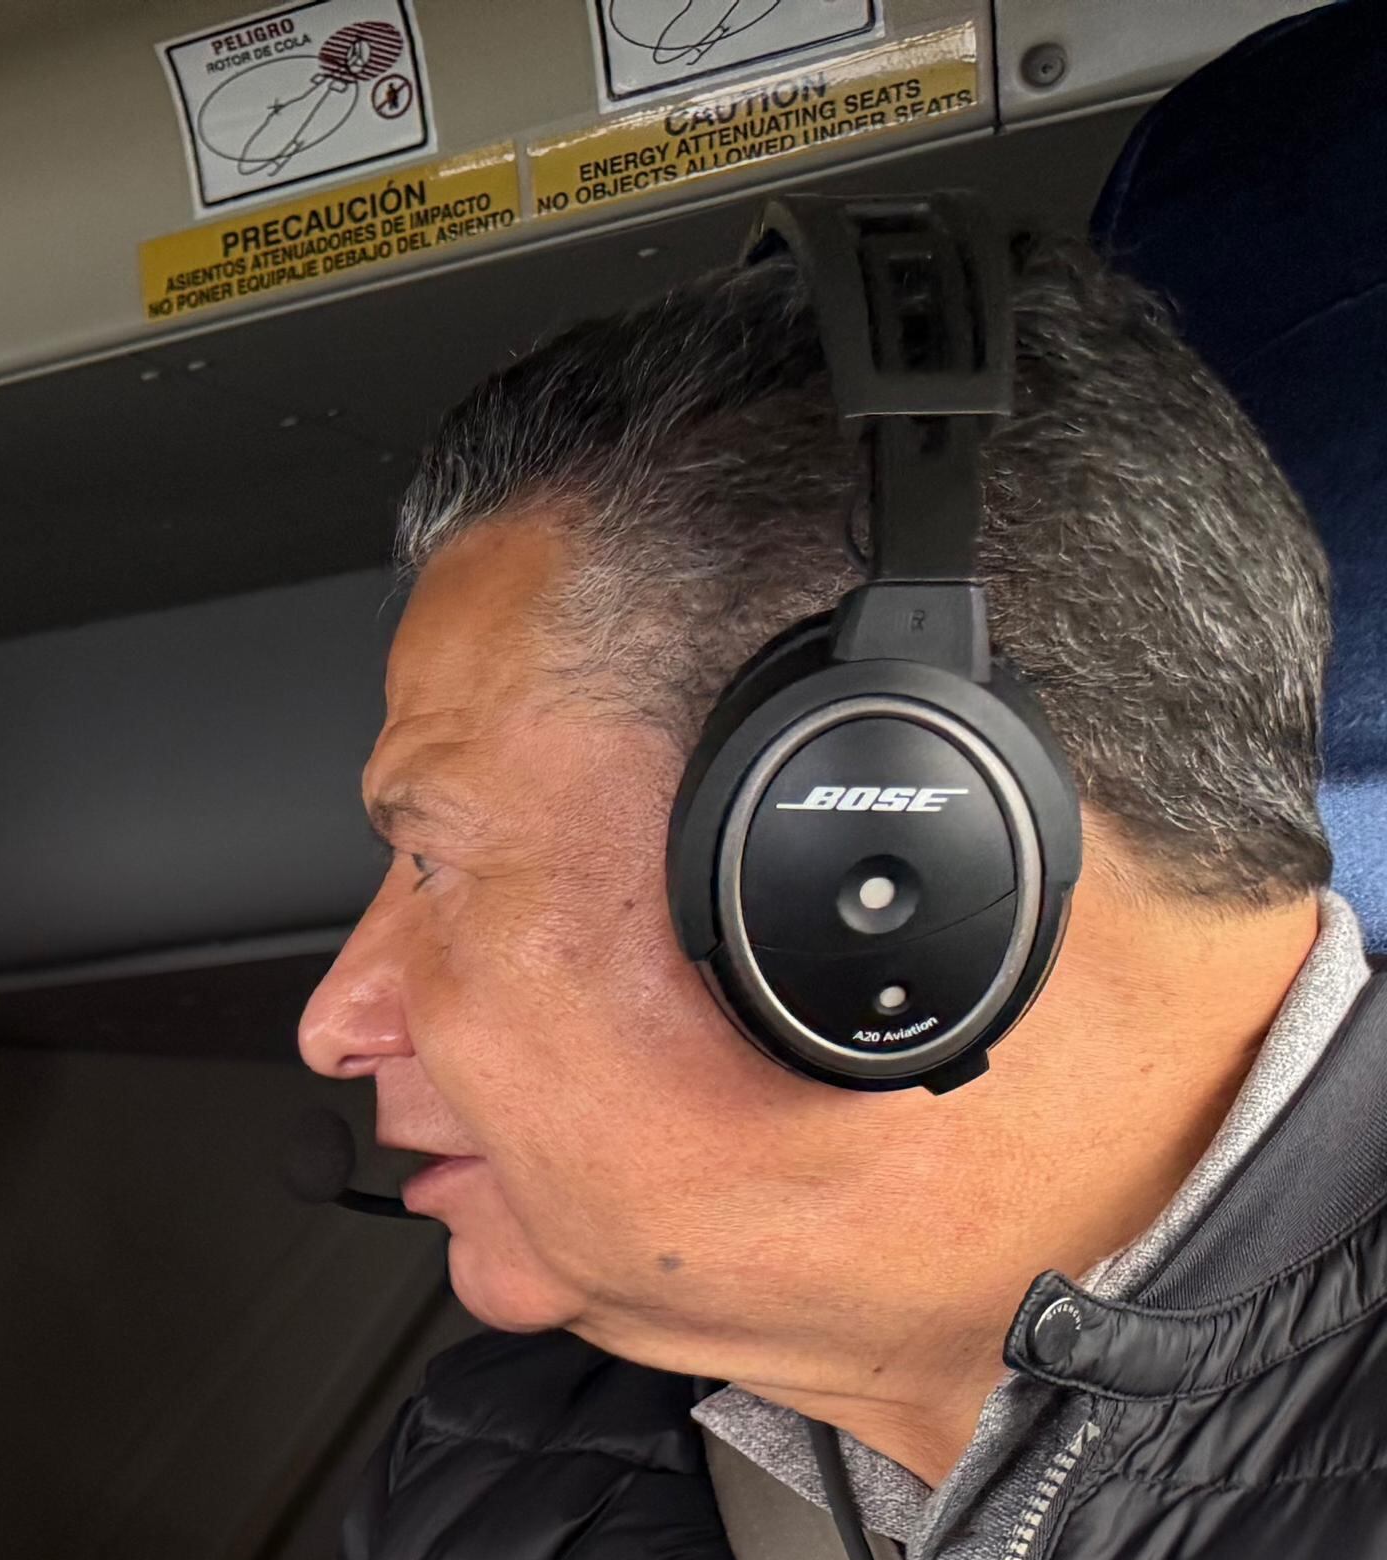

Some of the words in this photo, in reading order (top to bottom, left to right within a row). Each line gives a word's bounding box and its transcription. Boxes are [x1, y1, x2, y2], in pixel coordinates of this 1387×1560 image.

[206, 51, 252, 74] ROTOR
[254, 44, 273, 60] DE
[275, 33, 311, 53] COLA
[211, 18, 295, 55] PELIGRO
[579, 143, 669, 181] ENERGY
[676, 101, 836, 159] ATTENUATING
[844, 79, 921, 114] SEATS
[665, 72, 827, 136] CAUTION
[537, 192, 569, 214] NO
[575, 165, 677, 204] OBJECTS
[685, 134, 795, 175] ALLOWED
[803, 112, 885, 145] UNDER
[895, 89, 972, 123] SEATS
[165, 258, 246, 293] ASIENTOS
[251, 224, 376, 272] ATENUADORES
[381, 216, 406, 237] DE
[410, 193, 491, 229] IMPACTO
[222, 180, 426, 257] PRECAUCIÓN
[148, 299, 174, 318] NO
[177, 283, 232, 311] PONER
[237, 259, 319, 295] EQUIPAJE
[323, 241, 392, 273] DEBAJO
[397, 232, 431, 254] DEL
[435, 209, 514, 243] ASIENTO
[909, 609, 925, 632] R
[776, 786, 968, 812] BOSE
[852, 1030, 881, 1042] A20
[883, 1016, 939, 1042] Aviation
